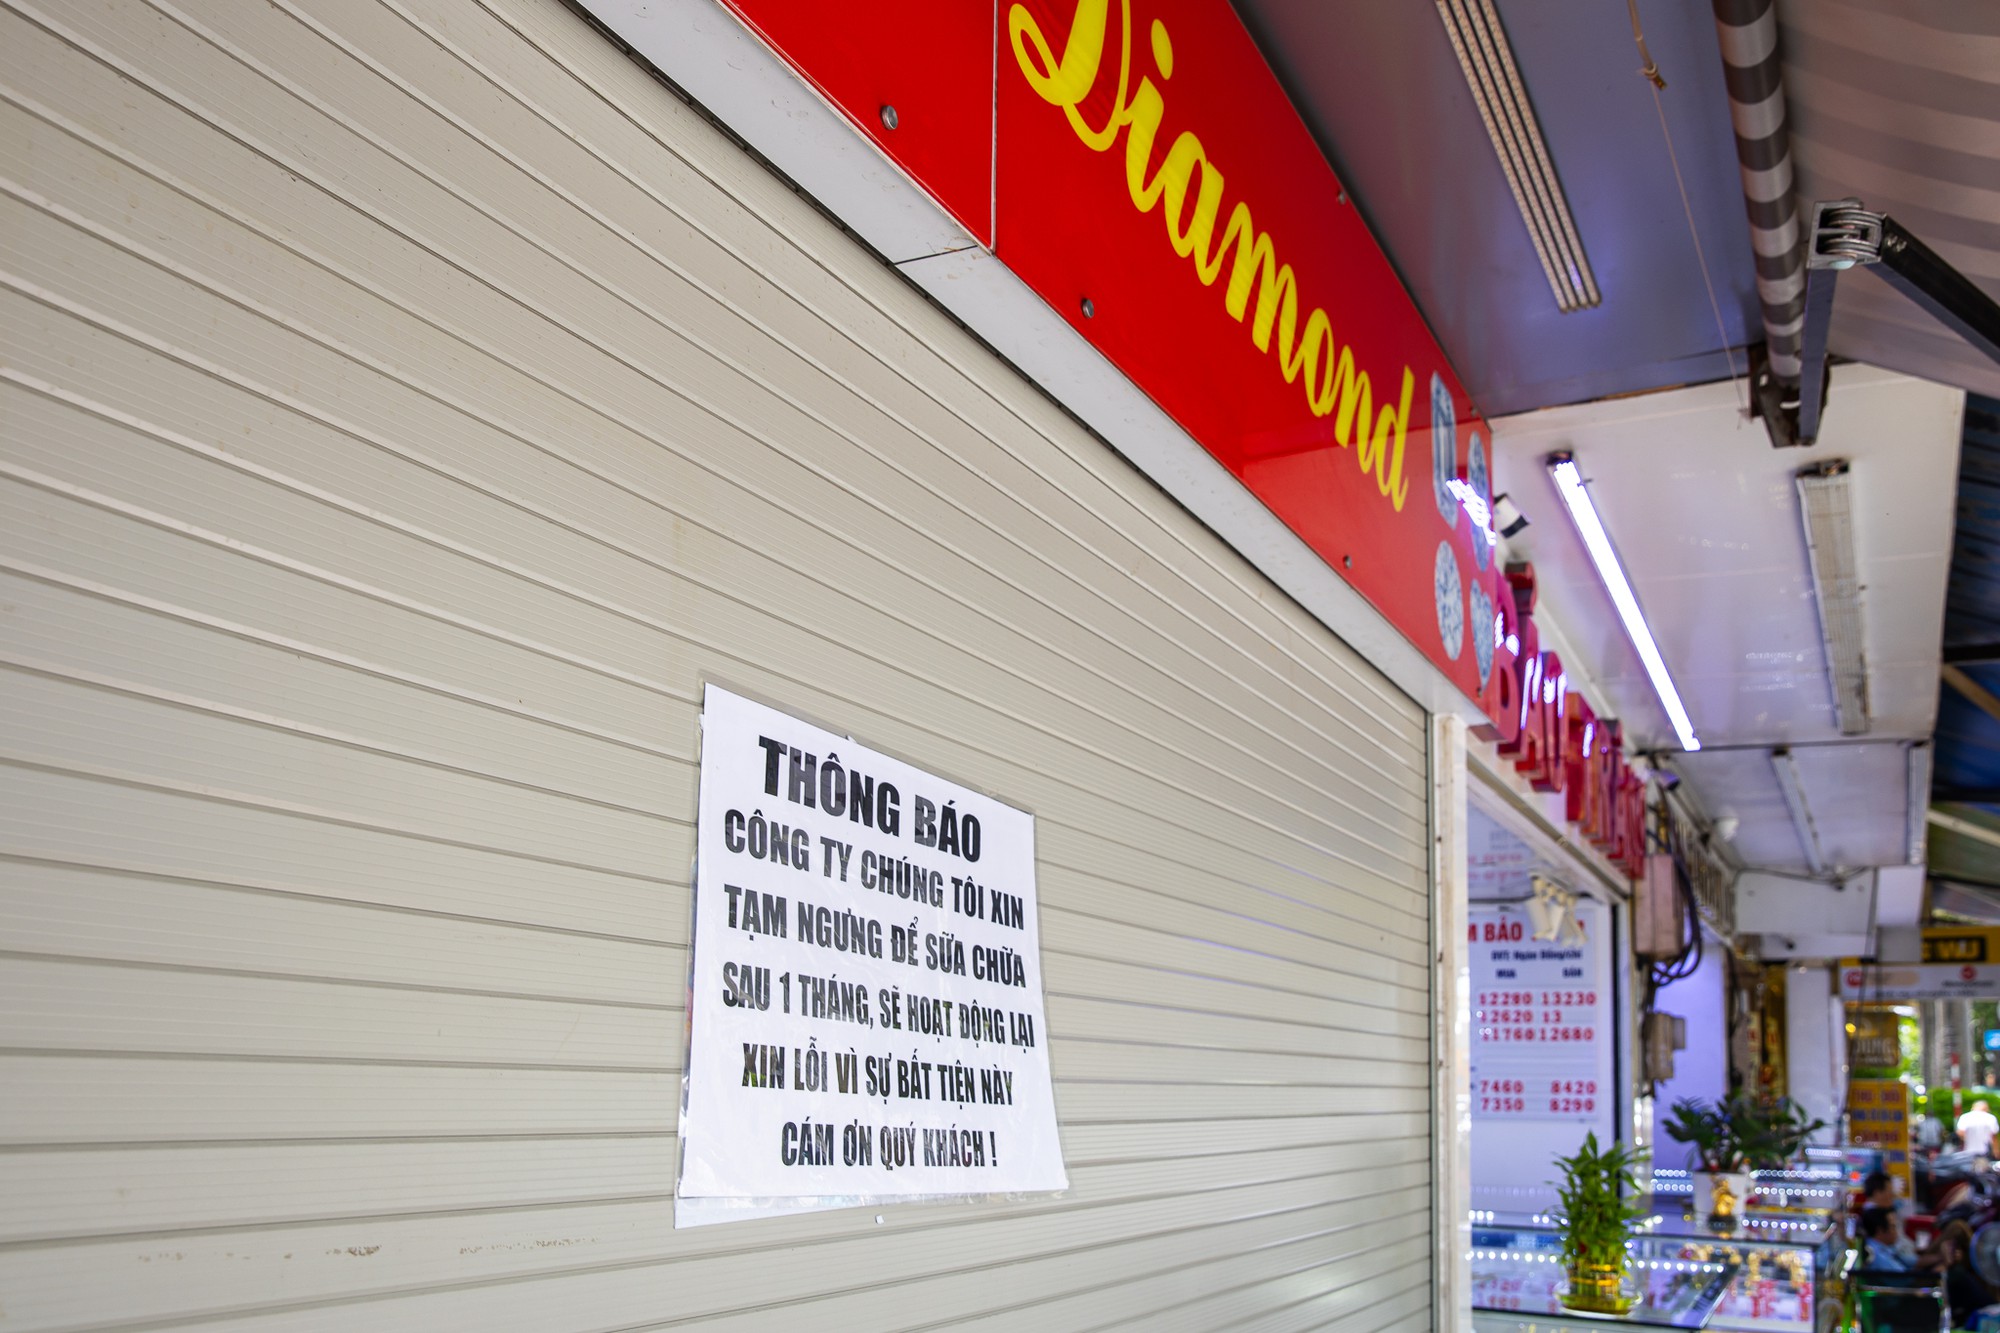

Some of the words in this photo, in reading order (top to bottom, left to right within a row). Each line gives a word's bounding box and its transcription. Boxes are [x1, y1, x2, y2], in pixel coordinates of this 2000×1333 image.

[758, 735, 900, 837] THÔNG
[914, 794, 981, 863] BÁO
[724, 809, 810, 872] CÔNG
[820, 836, 853, 882] TY
[861, 850, 943, 908] CHÚNG
[951, 875, 984, 920] TÔI
[990, 889, 1024, 930] XIN
[724, 884, 787, 941] TẠM
[798, 901, 882, 959] NGƯNG
[890, 916, 919, 966] ĐỂ
[925, 931, 966, 976] SỮA
[972, 945, 1026, 988] CHỮA
[723, 961, 770, 1011] SAU
[779, 972, 790, 1014] 1
[798, 974, 873, 1029] THÁNG,
[879, 985, 901, 1030] SẼ
[907, 994, 953, 1043] HOẠT
[958, 999, 1006, 1048] ĐỘNG
[1009, 1011, 1035, 1053] LẠI
[742, 1043, 785, 1089] XIN
[794, 1036, 828, 1092] LỖI
[835, 1047, 858, 1094] VÌ
[865, 1052, 892, 1105] SỰ
[897, 1048, 932, 1100] BẤT
[937, 1059, 976, 1110] TIỆN
[980, 1064, 1013, 1106] NÀY
[781, 1116, 834, 1167] CÁM
[843, 1119, 873, 1166] ƠN
[880, 1121, 916, 1171] QUÝ
[922, 1123, 985, 1167] KHÁCH
[989, 1131, 998, 1167] !
